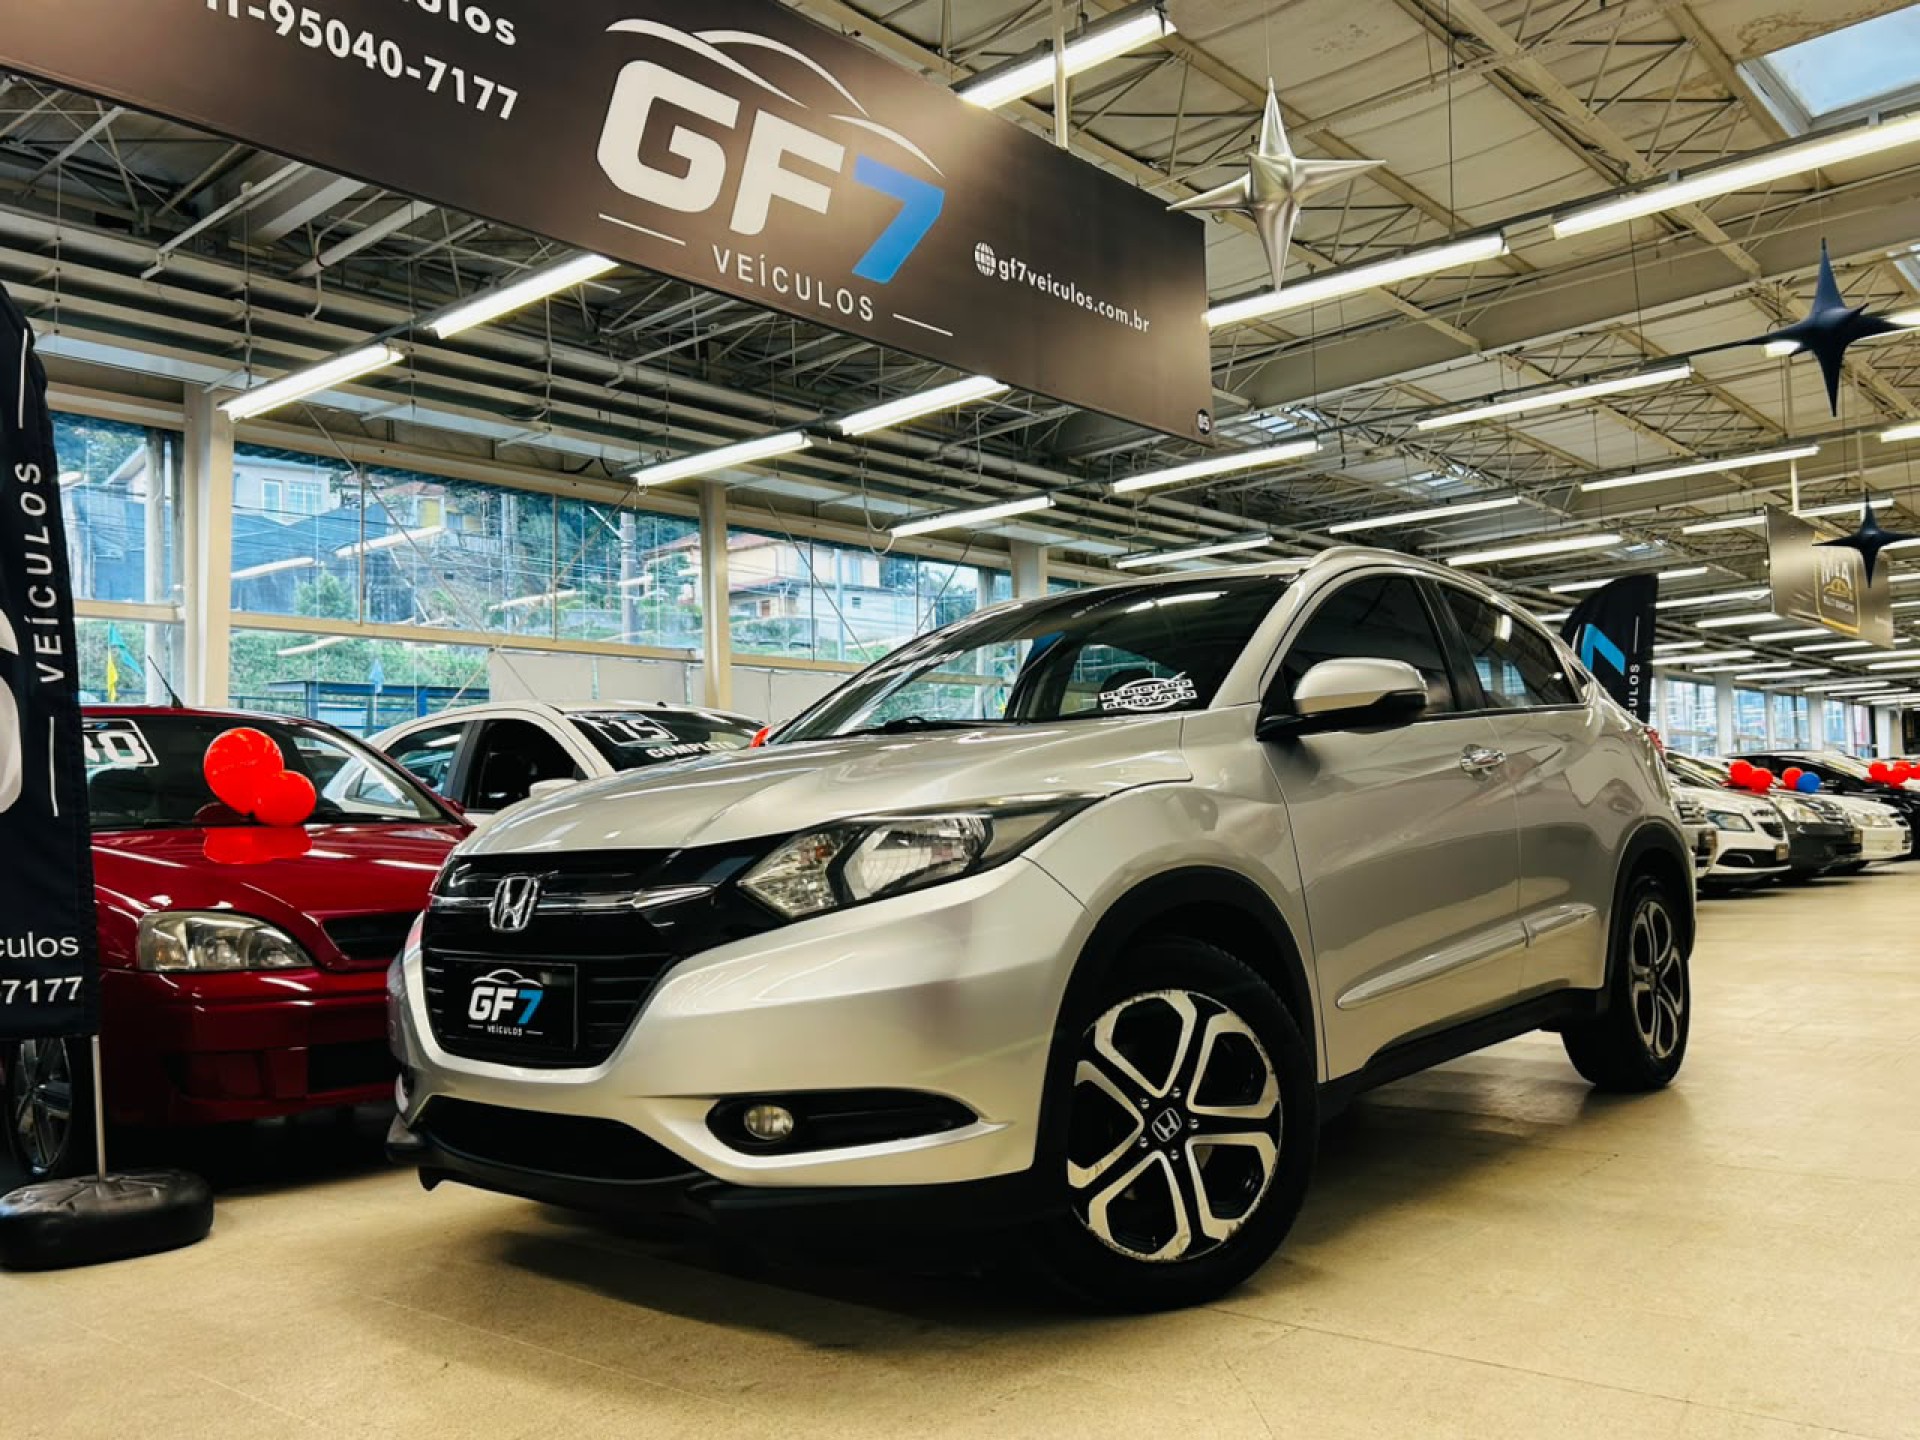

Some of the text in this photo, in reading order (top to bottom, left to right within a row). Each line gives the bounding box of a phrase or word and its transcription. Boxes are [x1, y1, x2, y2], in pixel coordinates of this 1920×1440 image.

[206, 0, 518, 120] -95040-7177
[597, 60, 945, 283] GF7
[713, 244, 874, 322] VEÍCULOS
[998, 257, 1150, 333] gf7veiculos.com.br
[14, 462, 66, 684] VEÍCULOS
[0, 930, 80, 958] ulos
[468, 986, 544, 1025] GF7
